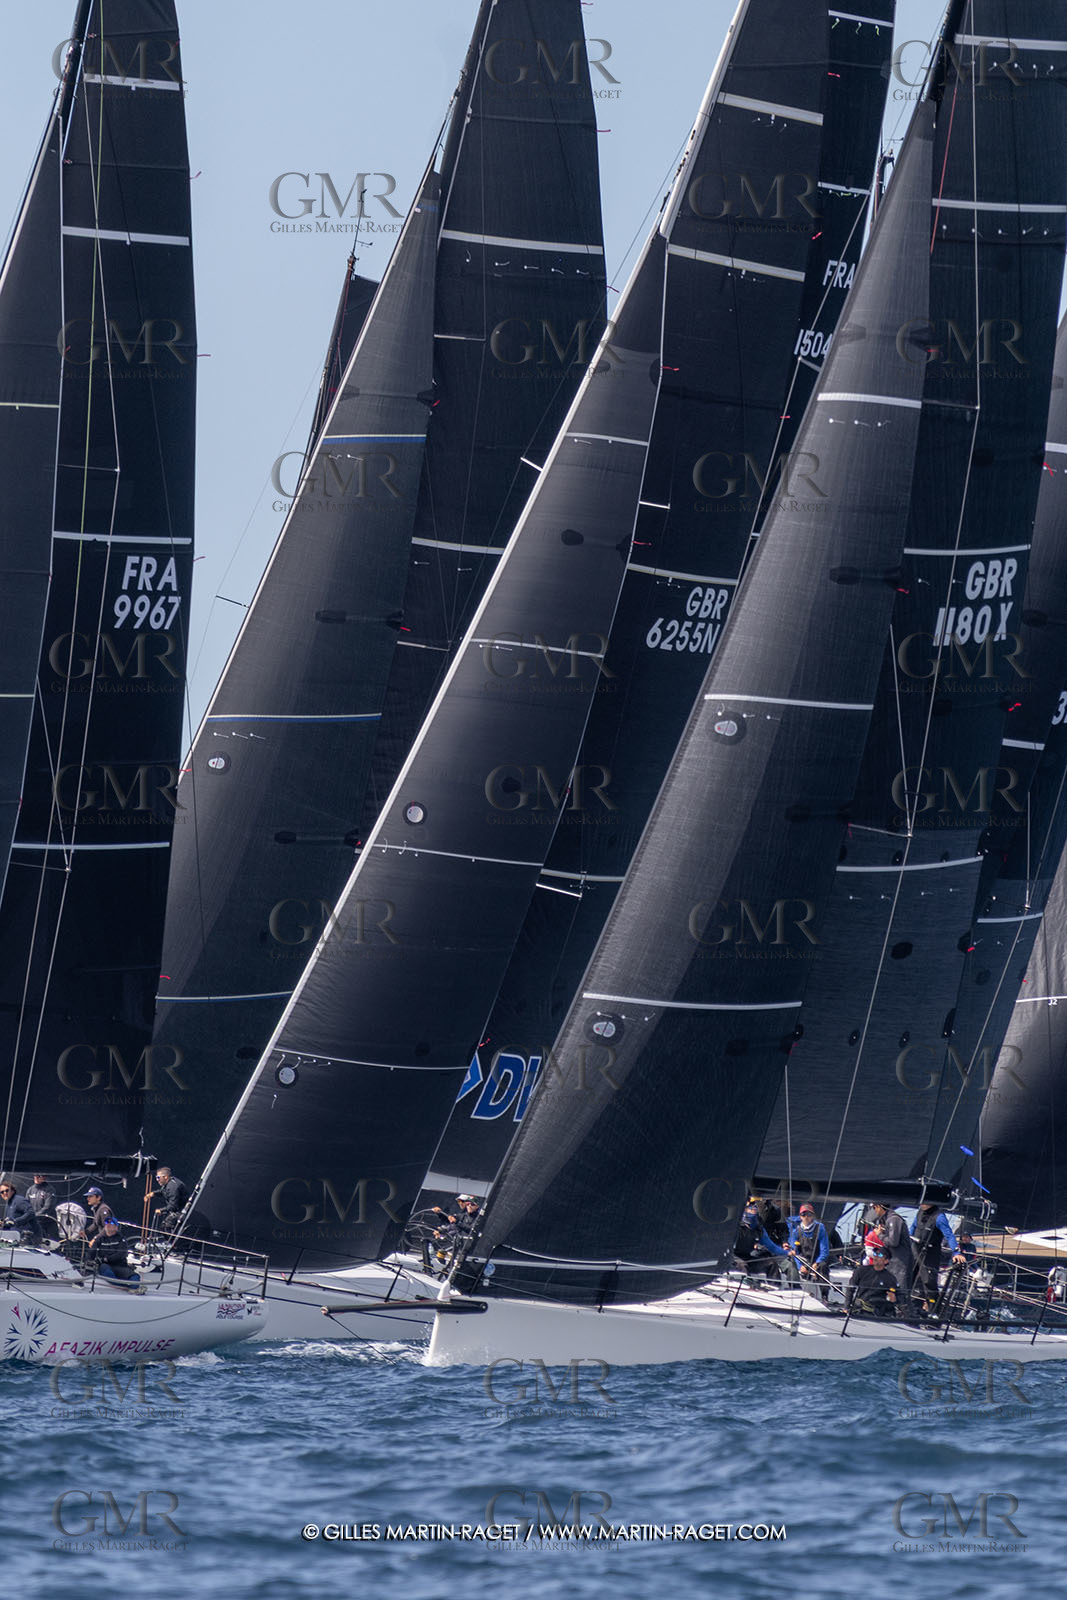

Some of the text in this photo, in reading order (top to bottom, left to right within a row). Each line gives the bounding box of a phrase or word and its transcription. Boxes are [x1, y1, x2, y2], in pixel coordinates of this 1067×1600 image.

[822, 260, 855, 289] FRA
[122, 555, 177, 591] FRA
[965, 558, 1017, 600] GBR
[114, 594, 181, 630] 9967
[686, 586, 728, 620] GBR
[646, 618, 720, 654] 6255N
[108, 1339, 175, 1354] IMPULSE
